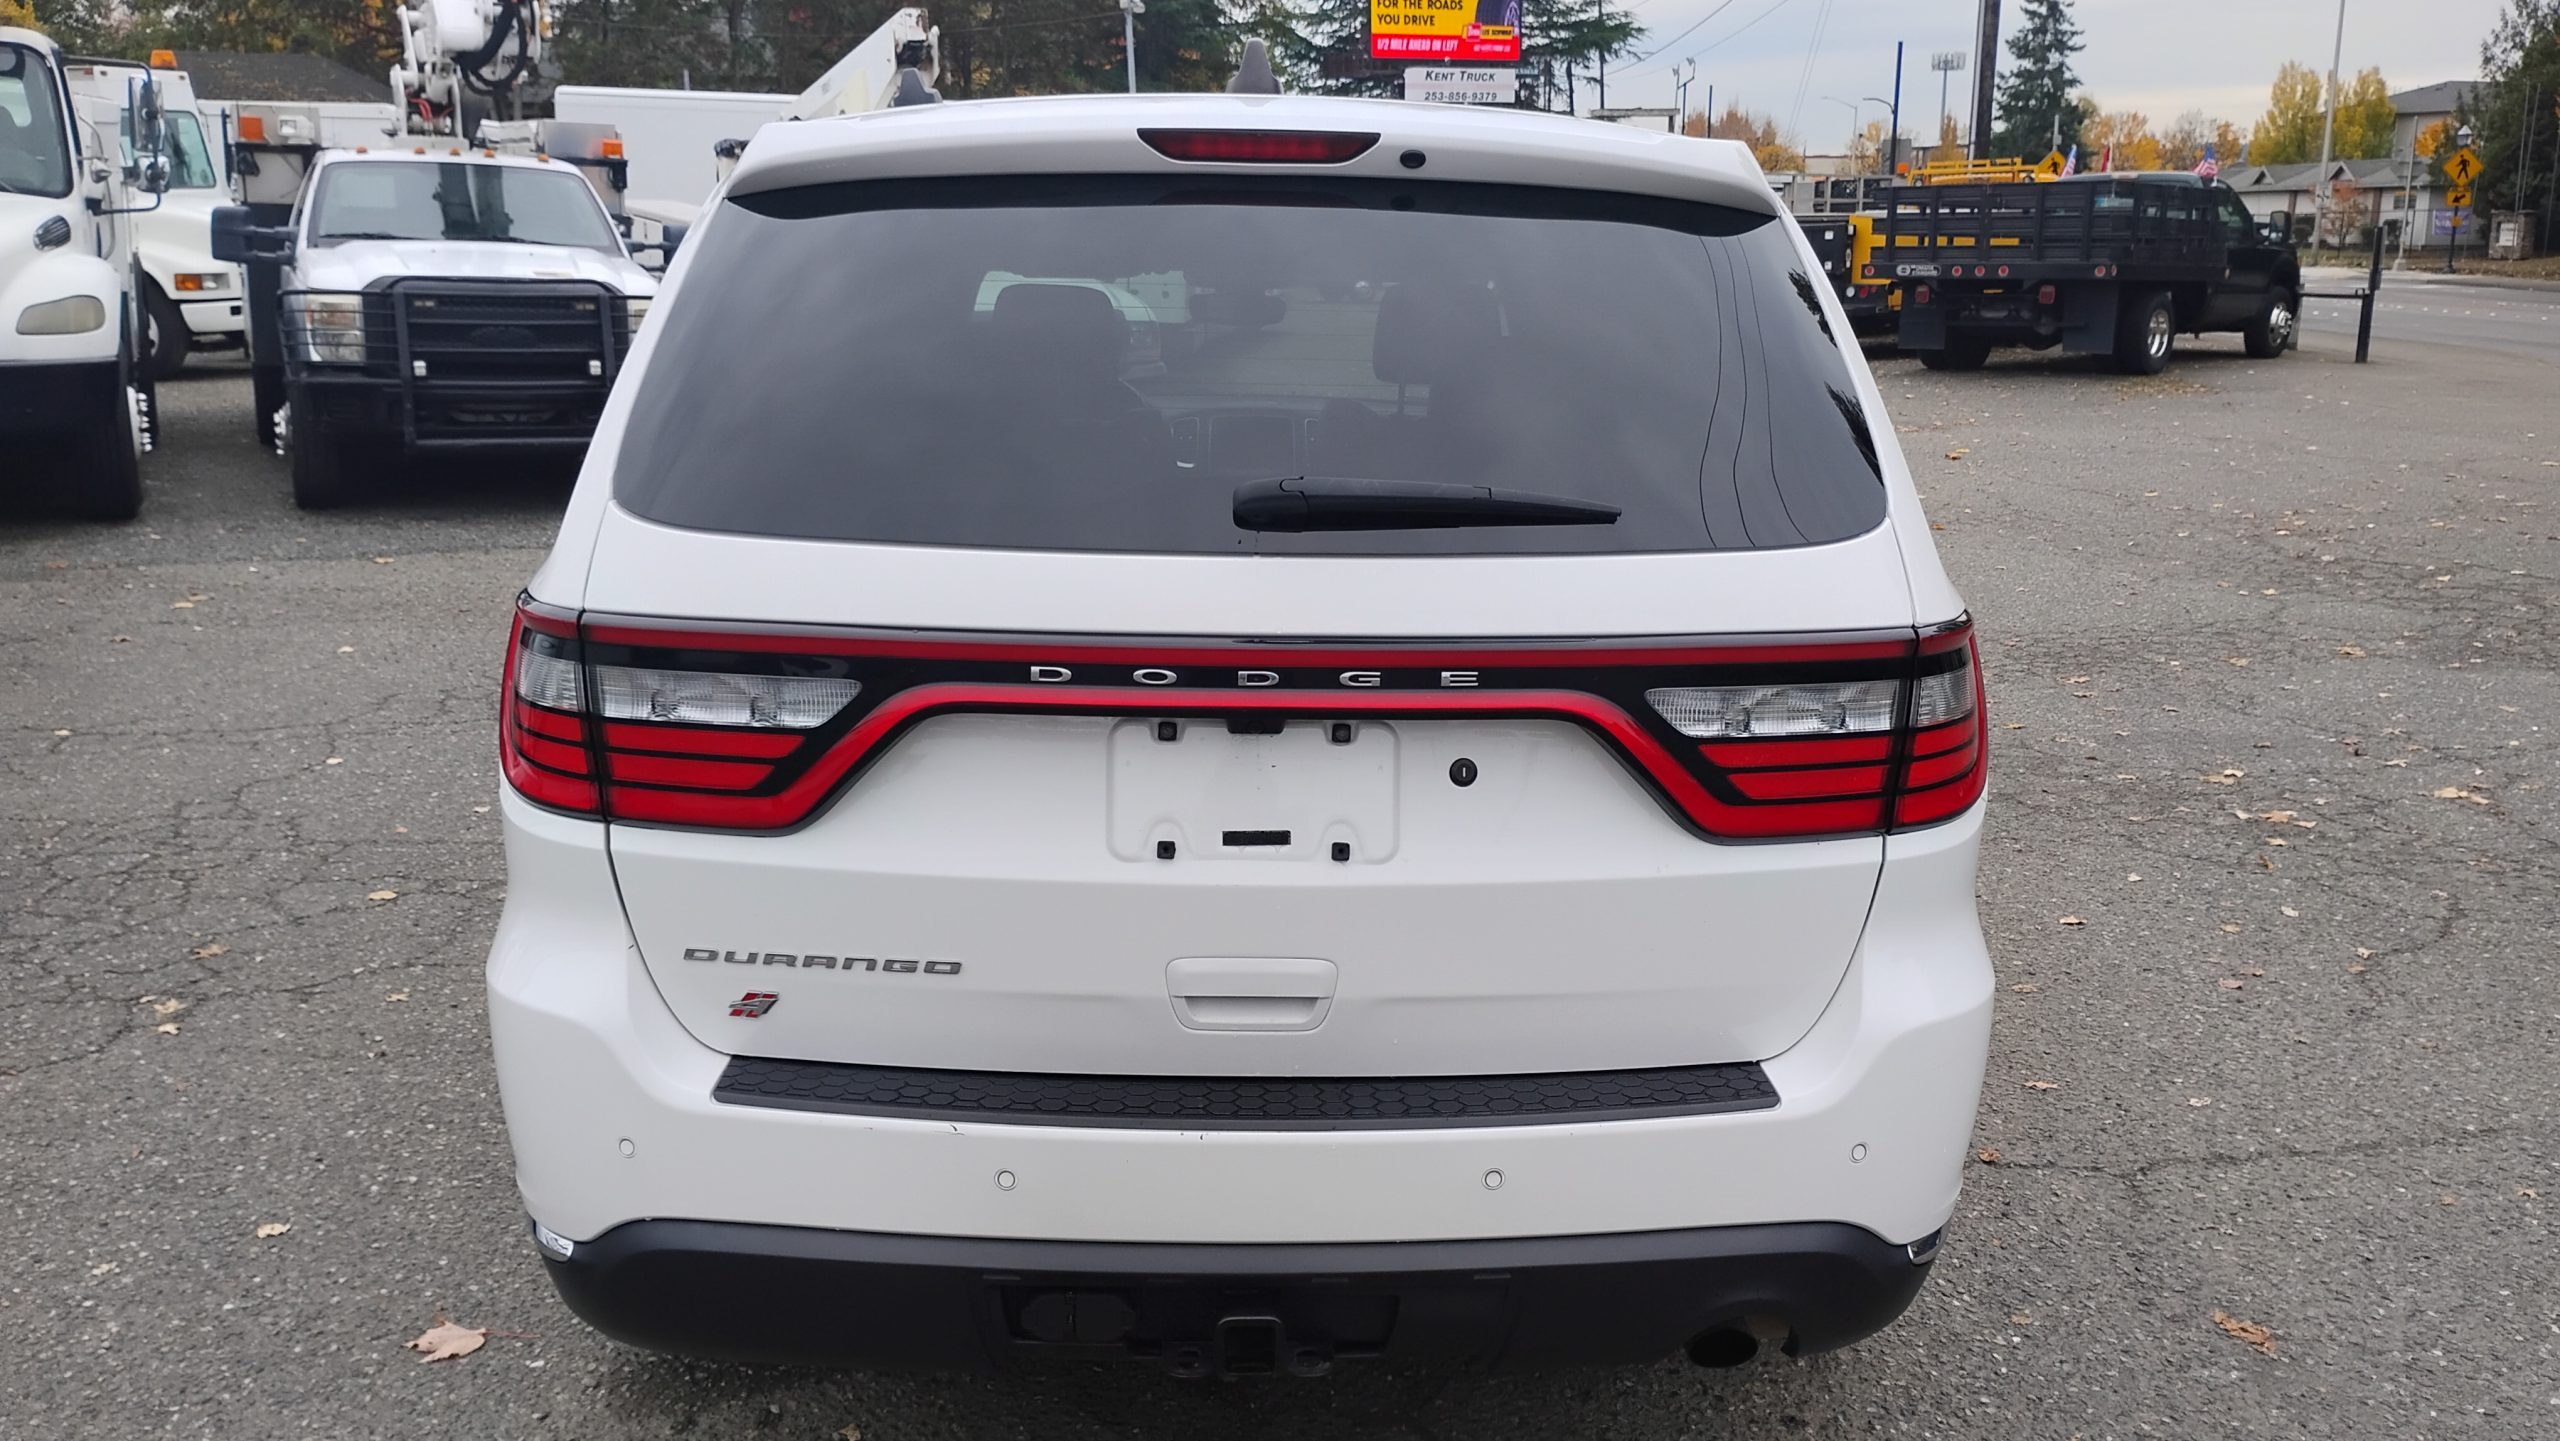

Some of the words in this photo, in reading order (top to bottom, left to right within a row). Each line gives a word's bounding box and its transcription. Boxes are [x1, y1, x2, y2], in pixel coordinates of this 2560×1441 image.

[1377, 0, 1398, 9] FOR
[1403, 0, 1423, 10] THE
[1427, 0, 1463, 10] ROADS
[1377, 14, 1400, 25] YOU
[1404, 15, 1435, 26] DRIVE
[1442, 40, 1459, 52] LEFT
[1425, 70, 1455, 82] KENT
[1460, 71, 1496, 82] TRUCK
[1424, 92, 1498, 101] 253-856-9379
[1029, 665, 1480, 687] DODGE
[683, 947, 963, 975] DURANGO
